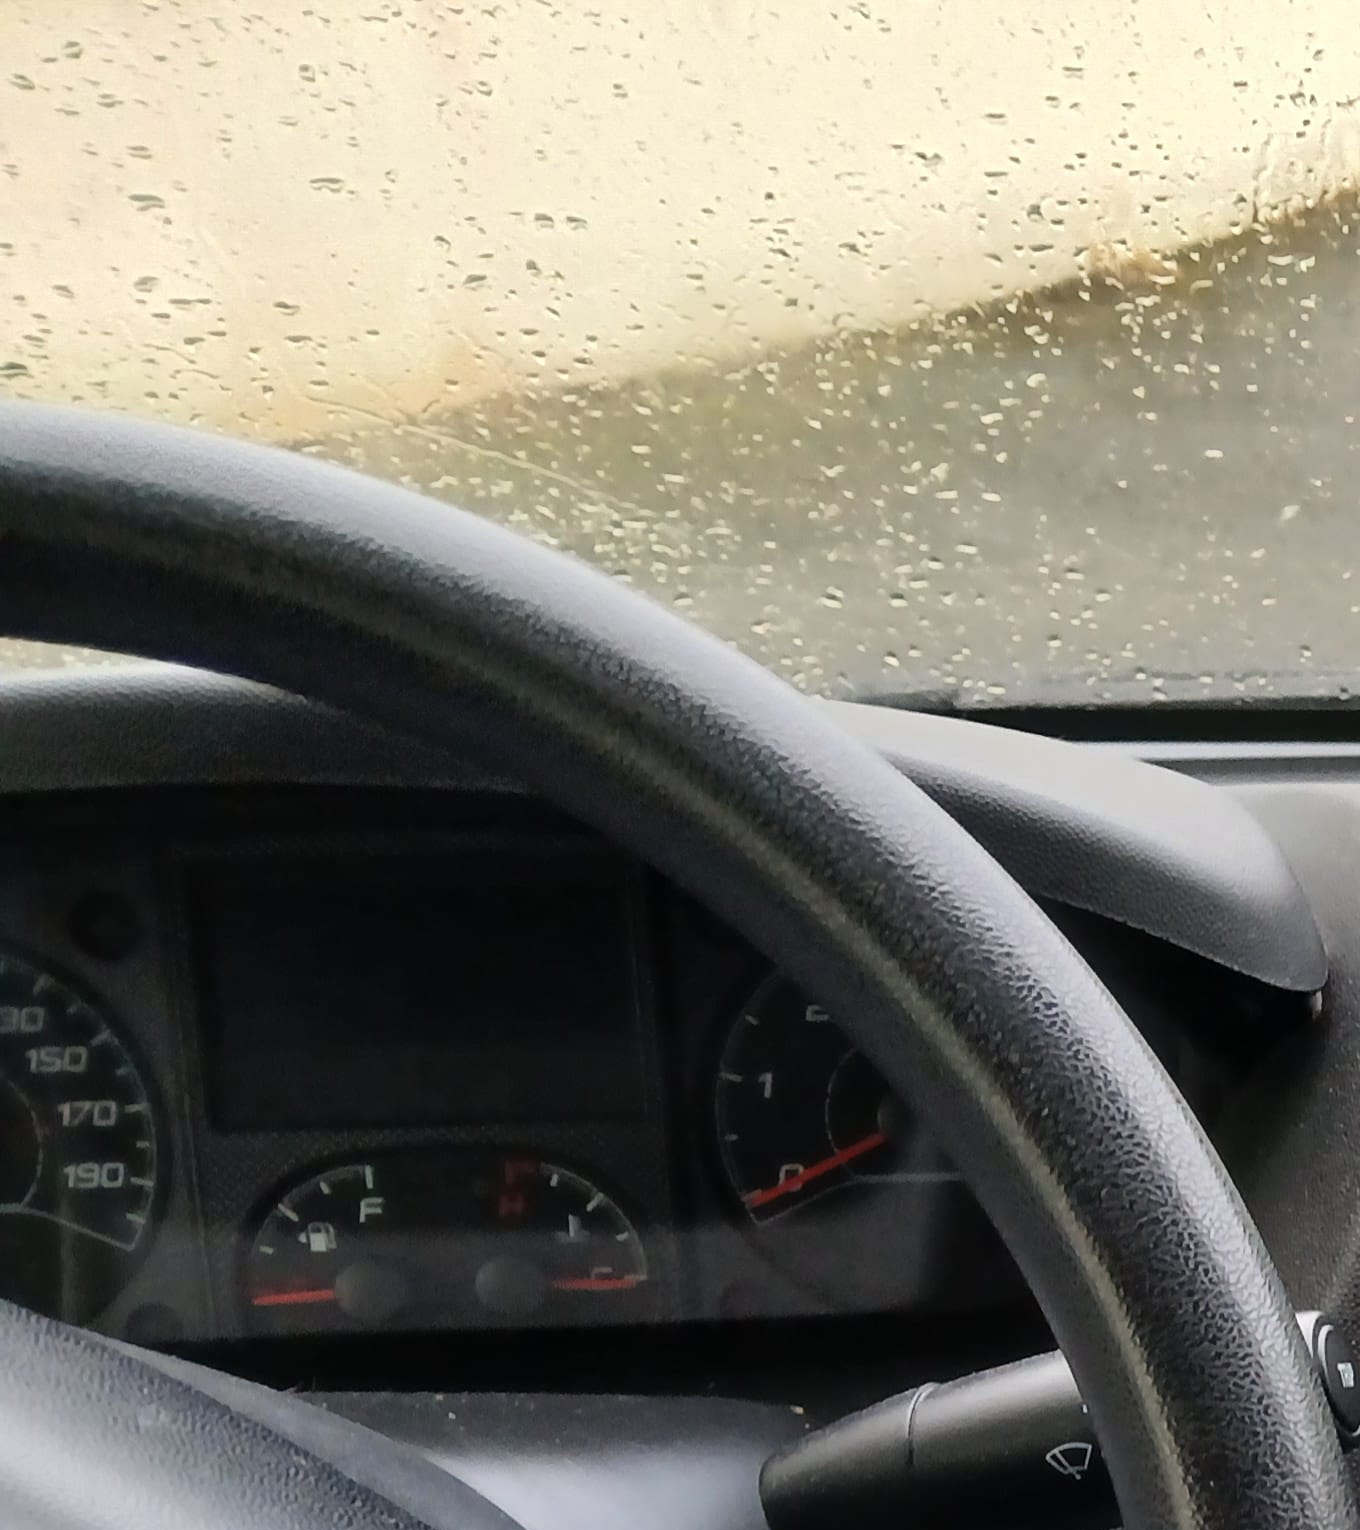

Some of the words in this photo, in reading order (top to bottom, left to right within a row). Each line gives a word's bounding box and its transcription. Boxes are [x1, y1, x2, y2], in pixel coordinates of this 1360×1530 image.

[0, 1003, 47, 1036] 30
[25, 1045, 88, 1074] 150
[758, 1072, 773, 1099] 1
[57, 1100, 118, 1127] 170
[62, 1161, 125, 1189] 190
[359, 1196, 384, 1224] F
